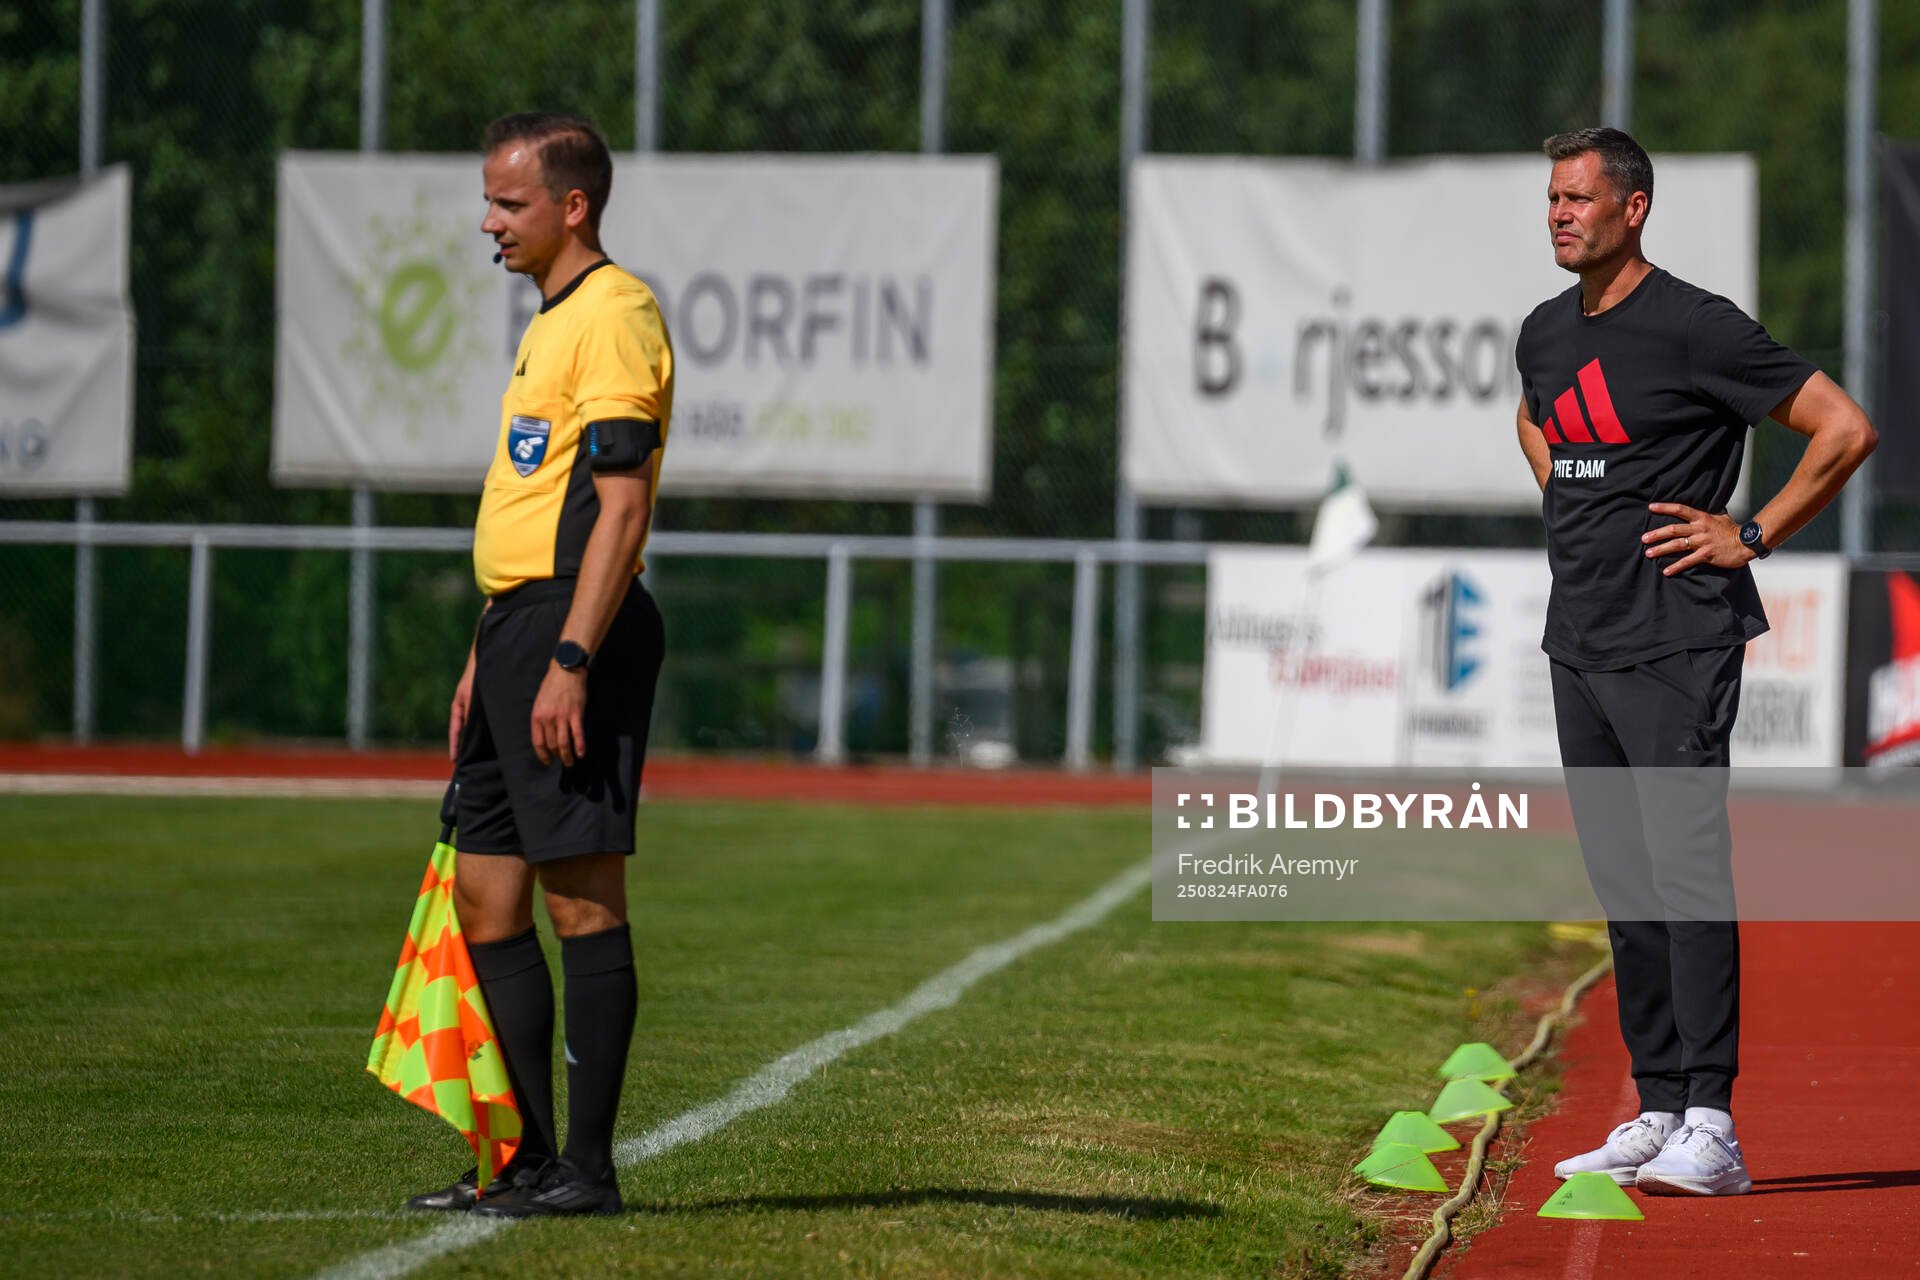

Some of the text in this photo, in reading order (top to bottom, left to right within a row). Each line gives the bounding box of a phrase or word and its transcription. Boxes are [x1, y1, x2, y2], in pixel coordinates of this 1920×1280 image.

[508, 270, 934, 370] EORFIN
[1554, 459, 1606, 479] PITE DAM
